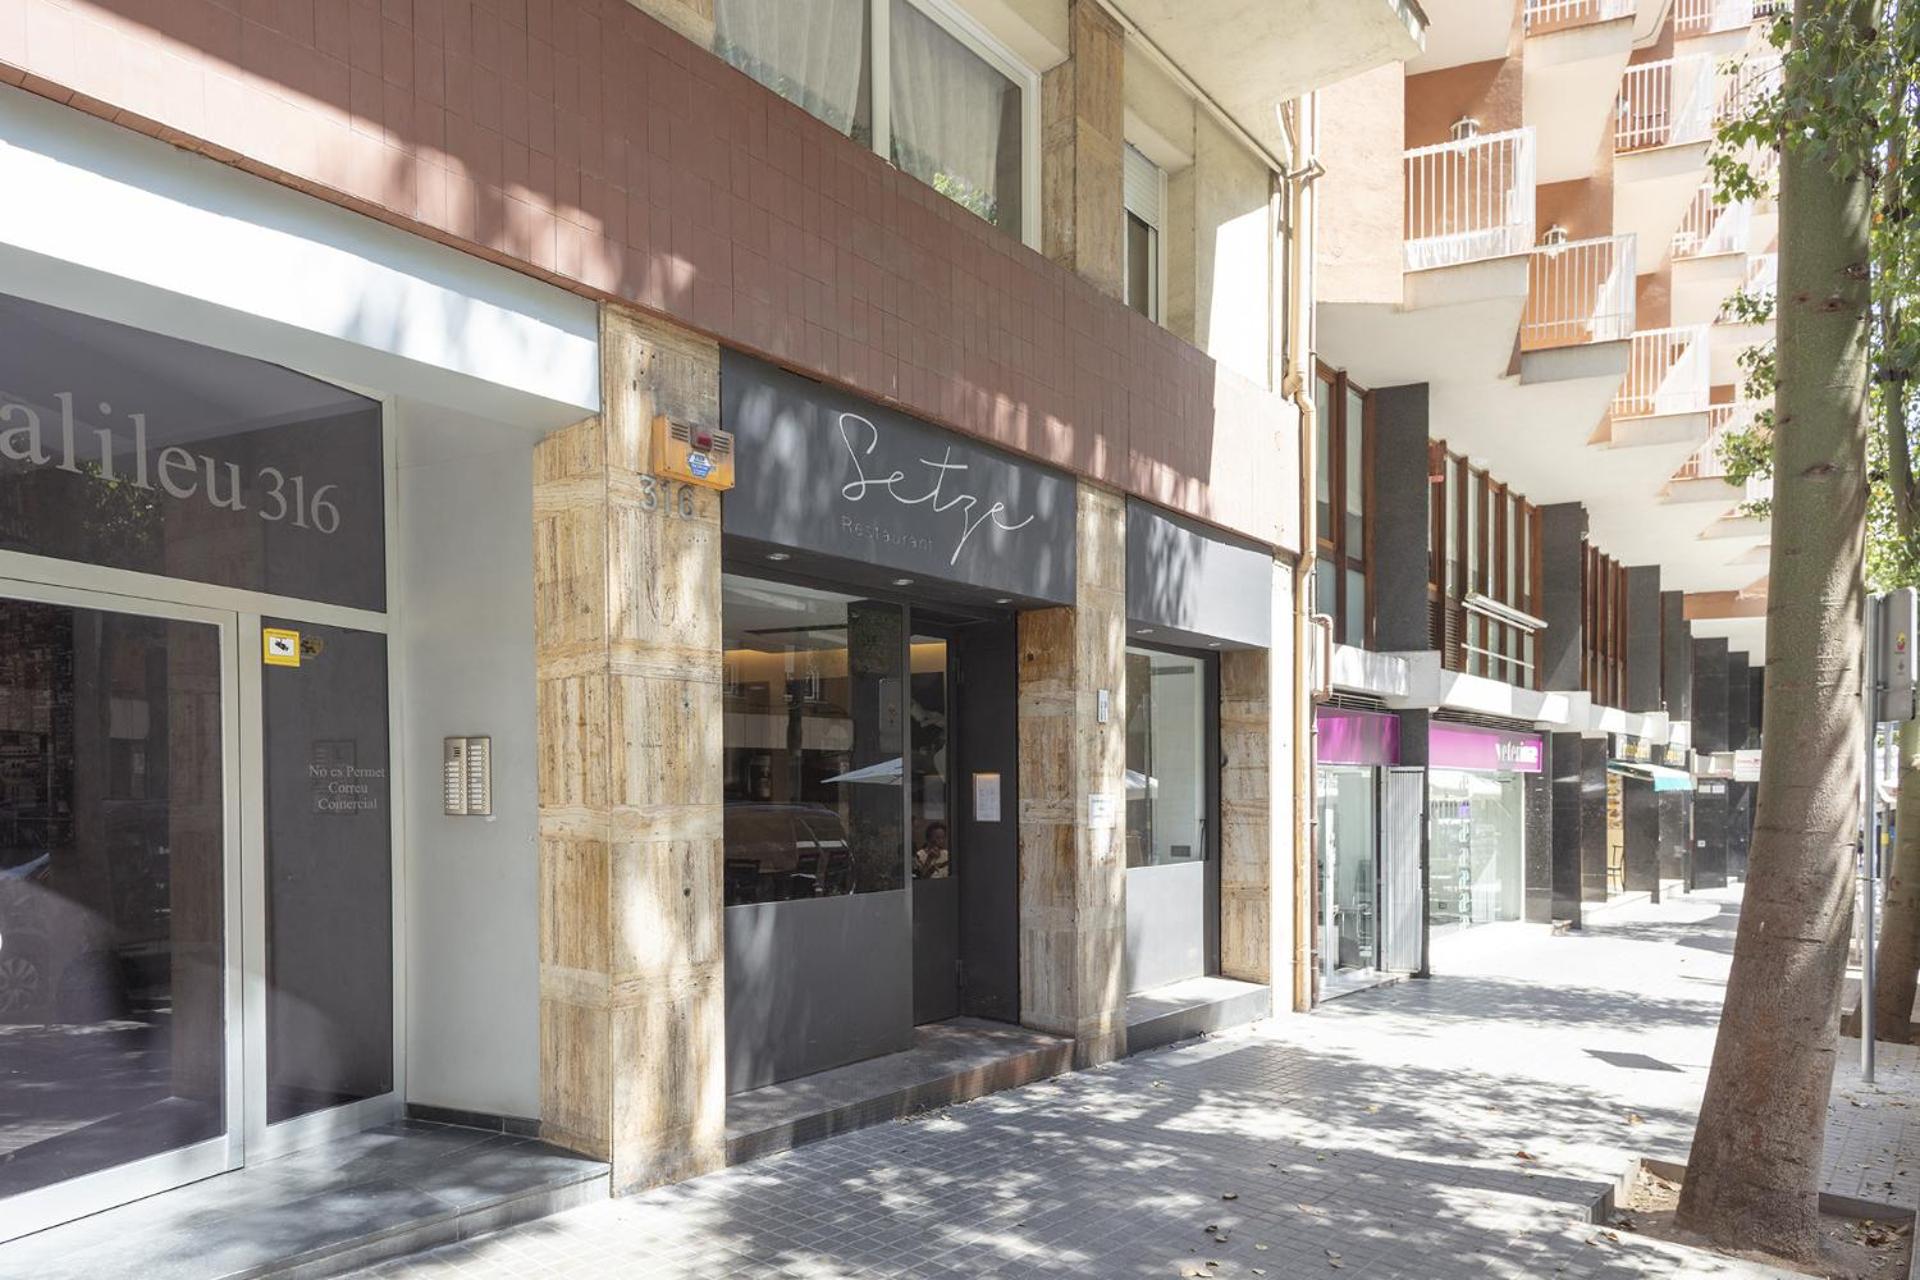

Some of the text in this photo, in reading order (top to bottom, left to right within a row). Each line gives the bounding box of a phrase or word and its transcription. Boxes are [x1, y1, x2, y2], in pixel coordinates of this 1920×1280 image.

[258, 466, 341, 534] 316
[640, 475, 696, 521] 316
[839, 412, 1035, 566] Setze
[841, 515, 933, 551] Restaurant
[309, 763, 328, 777] No
[346, 766, 385, 778] Permet
[328, 782, 368, 794] Correu
[318, 797, 378, 810] Comercial
